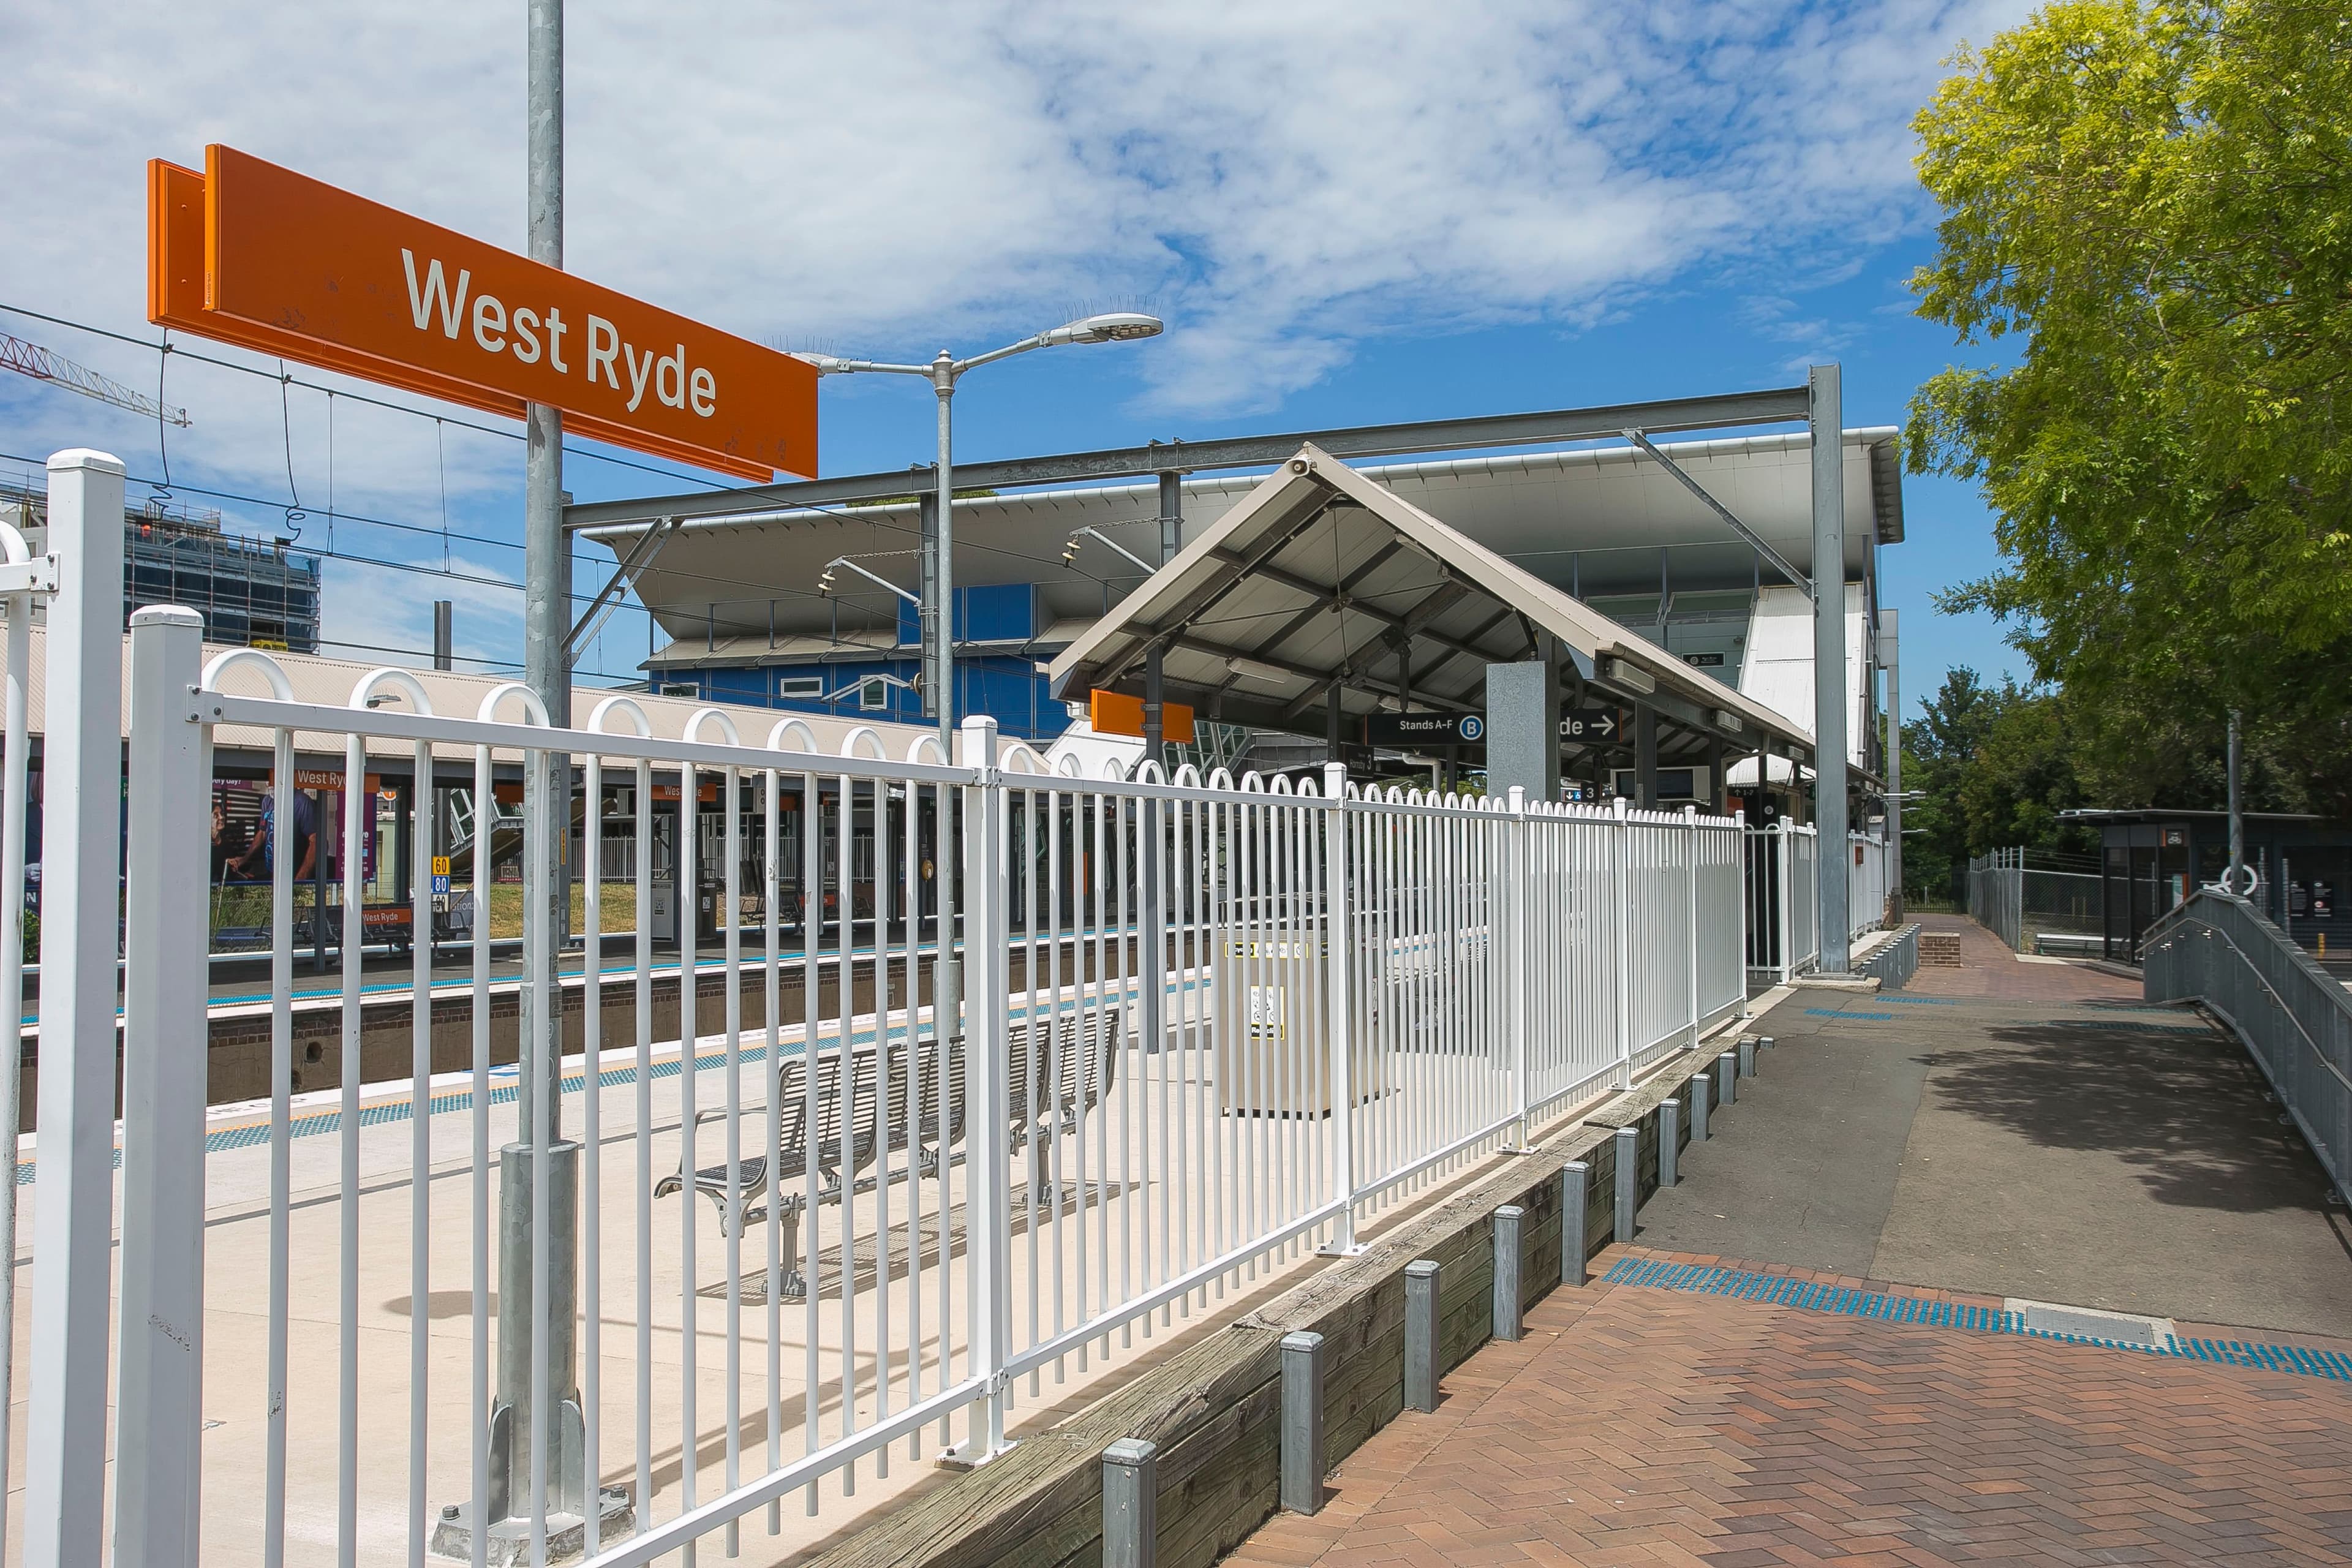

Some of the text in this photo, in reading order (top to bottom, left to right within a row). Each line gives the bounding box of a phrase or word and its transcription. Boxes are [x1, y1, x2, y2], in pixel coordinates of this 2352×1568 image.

[401, 247, 716, 418] West Ryde
[1400, 720, 1452, 730] Stands A-F
[1467, 722, 1476, 735] B
[1559, 717, 1583, 734] de
[1367, 754, 1371, 770] 3
[298, 769, 346, 788] West Ry
[665, 785, 681, 796] Wes
[1586, 787, 1594, 799] 3
[435, 858, 447, 873] 60
[435, 877, 447, 892] 80
[362, 912, 398, 922] West Ryde
